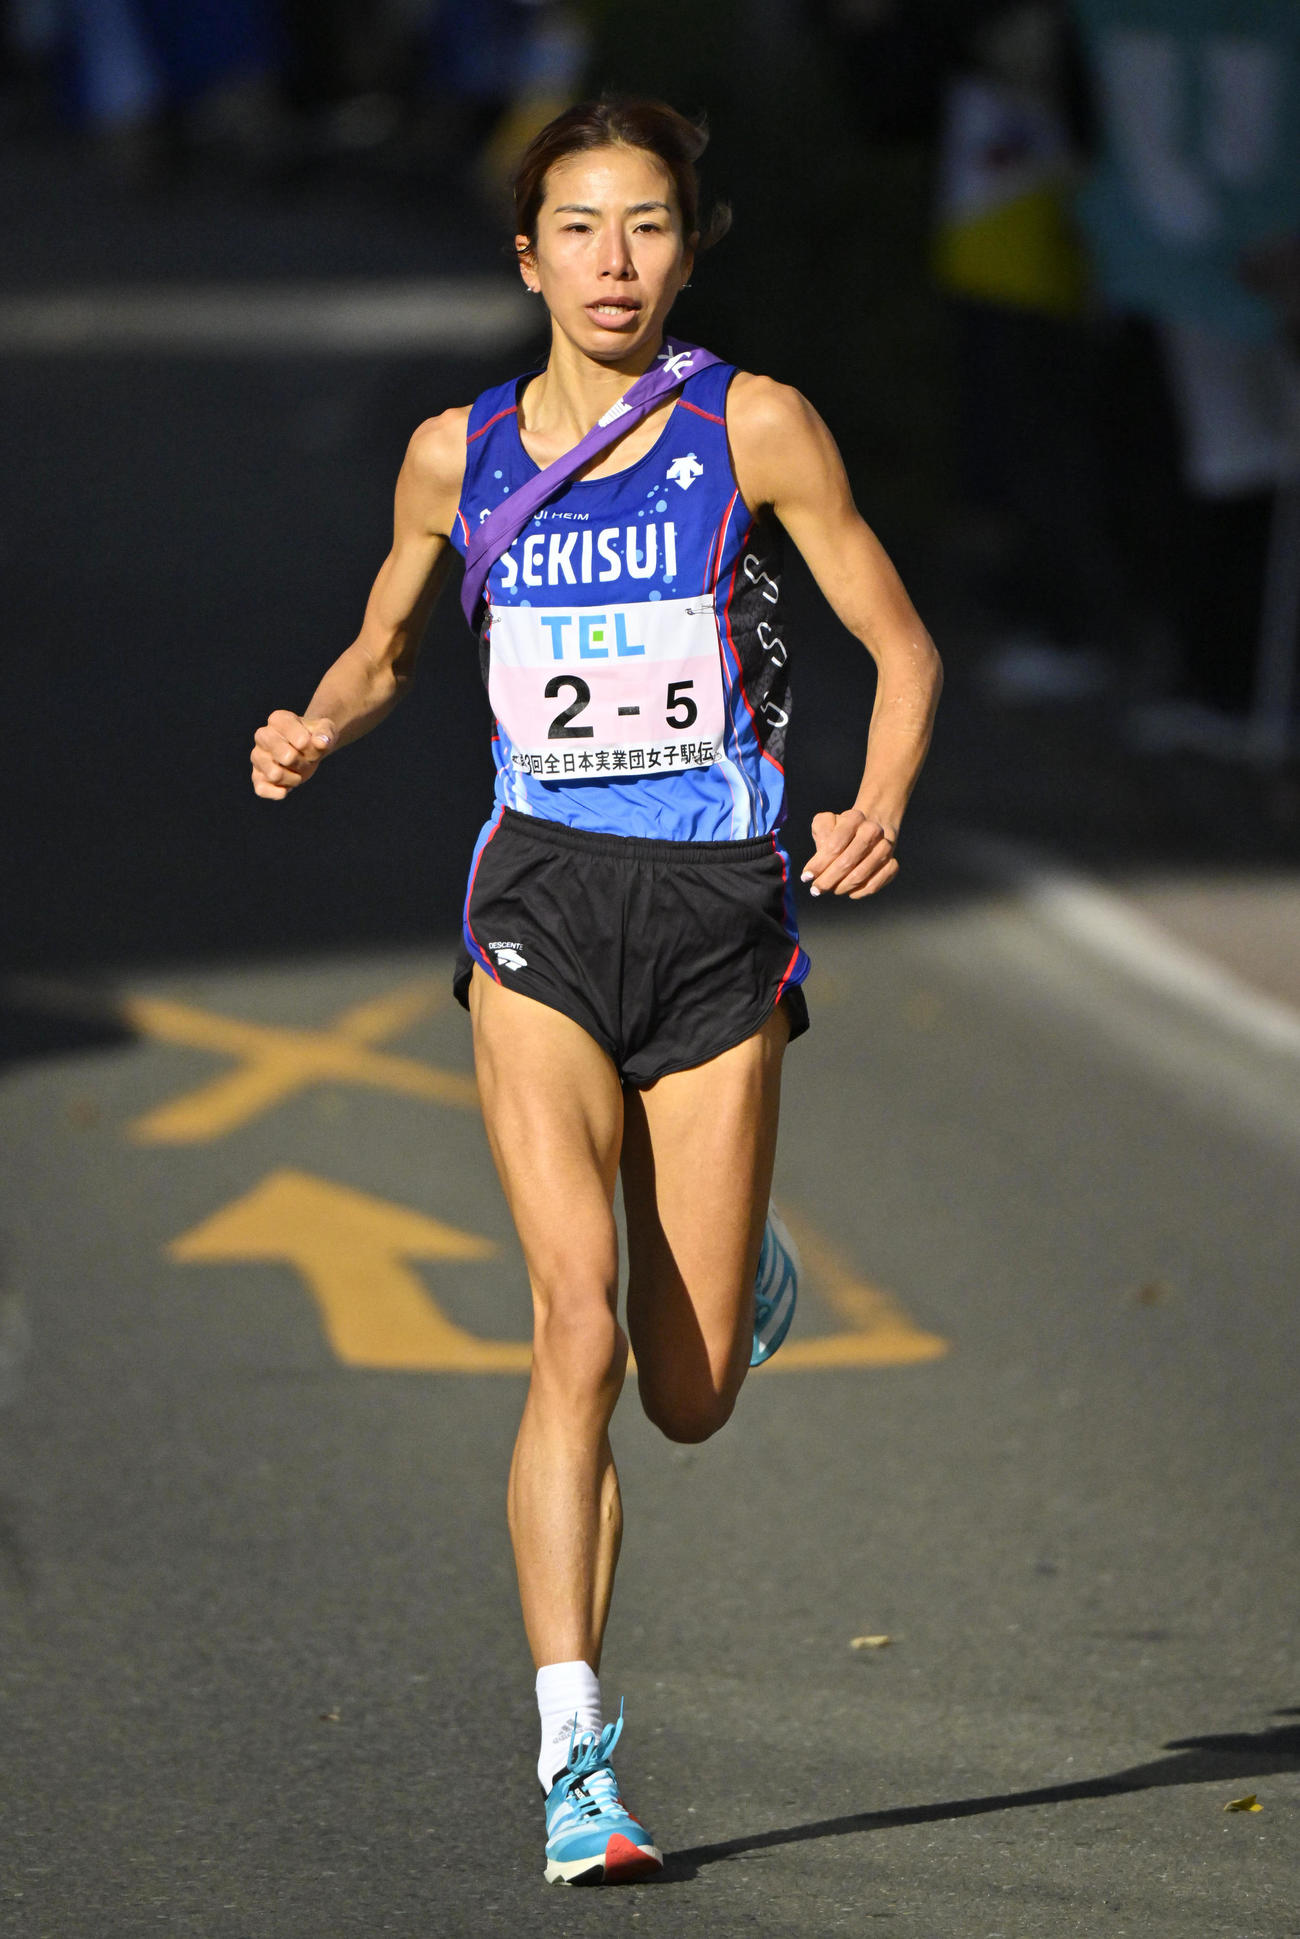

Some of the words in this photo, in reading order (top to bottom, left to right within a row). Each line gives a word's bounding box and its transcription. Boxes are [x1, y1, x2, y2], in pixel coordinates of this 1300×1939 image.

[499, 522, 677, 588] SEKISUI
[541, 613, 645, 660] TEL
[544, 675, 594, 740] 2
[665, 680, 698, 729] 5
[511, 742, 713, 775] 3回全日本実業団女子駅伝
[488, 941, 524, 951] DESCENTE
